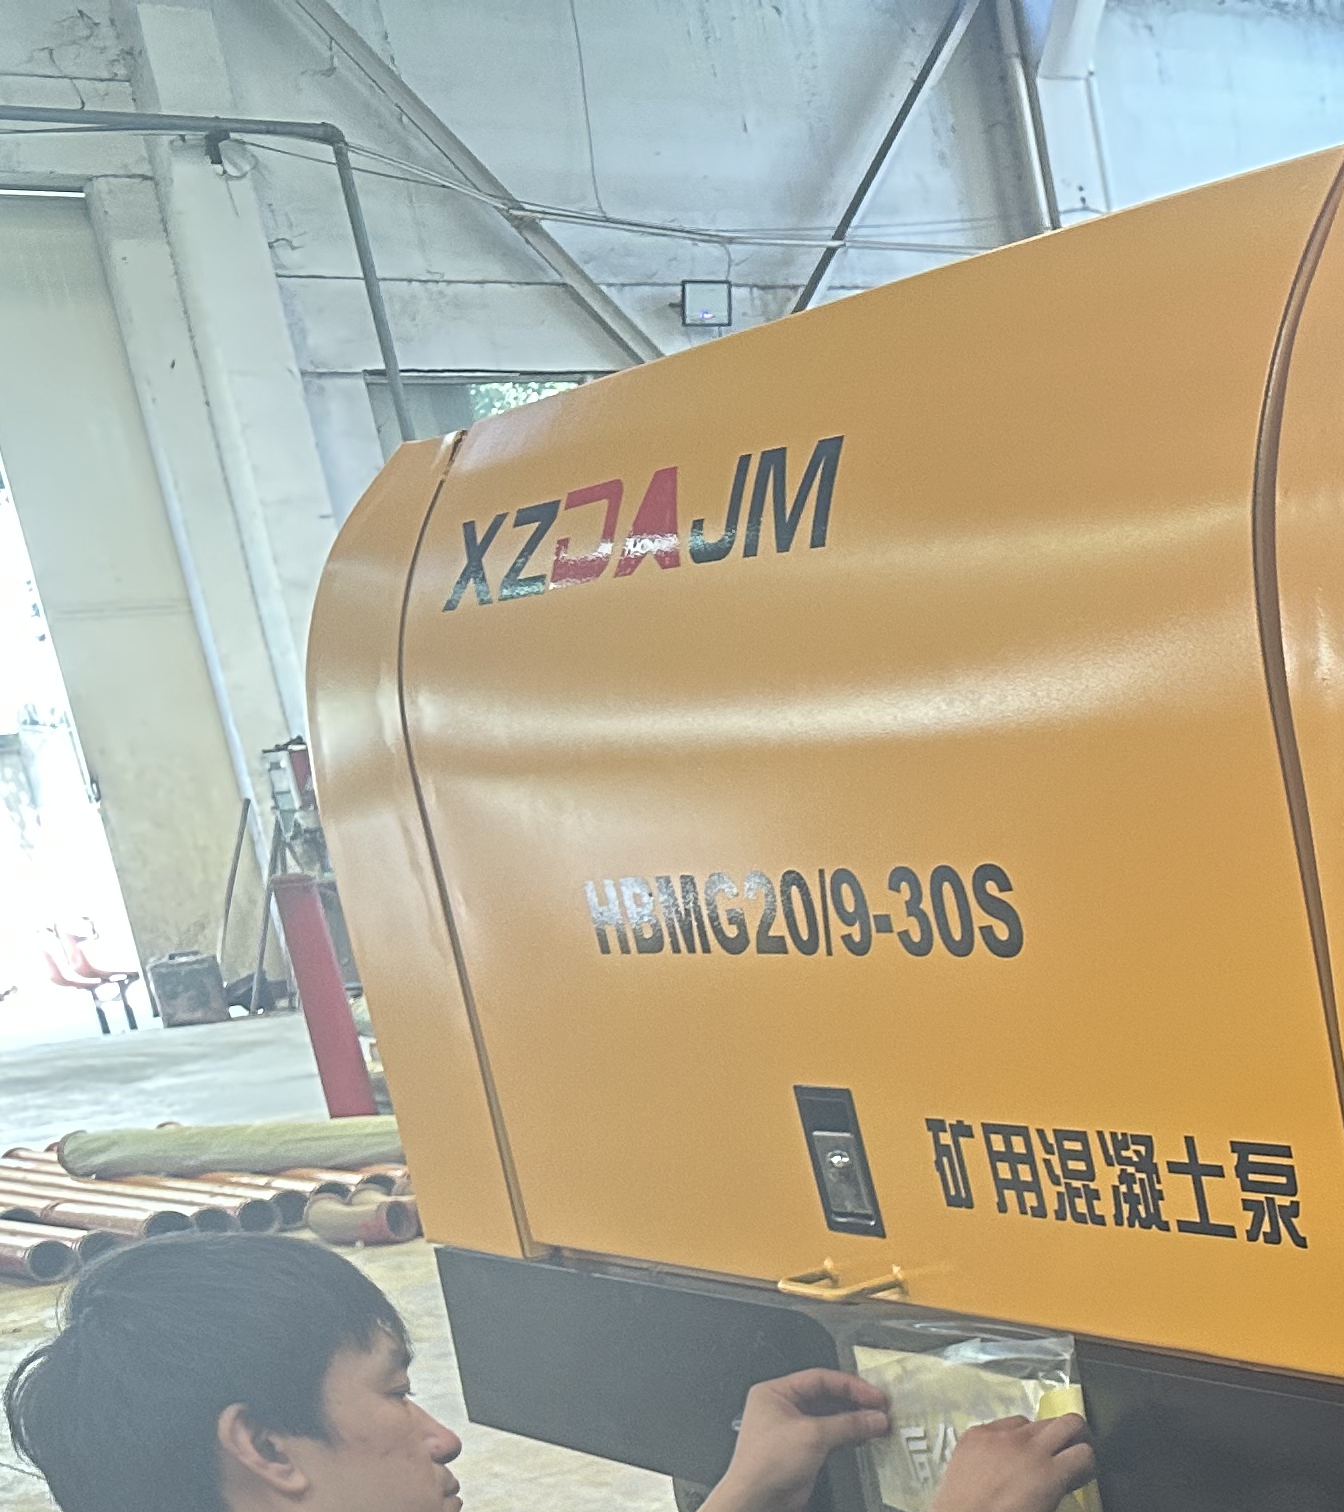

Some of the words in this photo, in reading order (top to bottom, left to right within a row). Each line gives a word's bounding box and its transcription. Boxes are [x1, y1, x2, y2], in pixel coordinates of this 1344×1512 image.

[442, 435, 845, 613] XZDAJM
[583, 862, 1024, 959] HBMG20/9-30S
[924, 1117, 1308, 1249] 矿用混凝土泵
